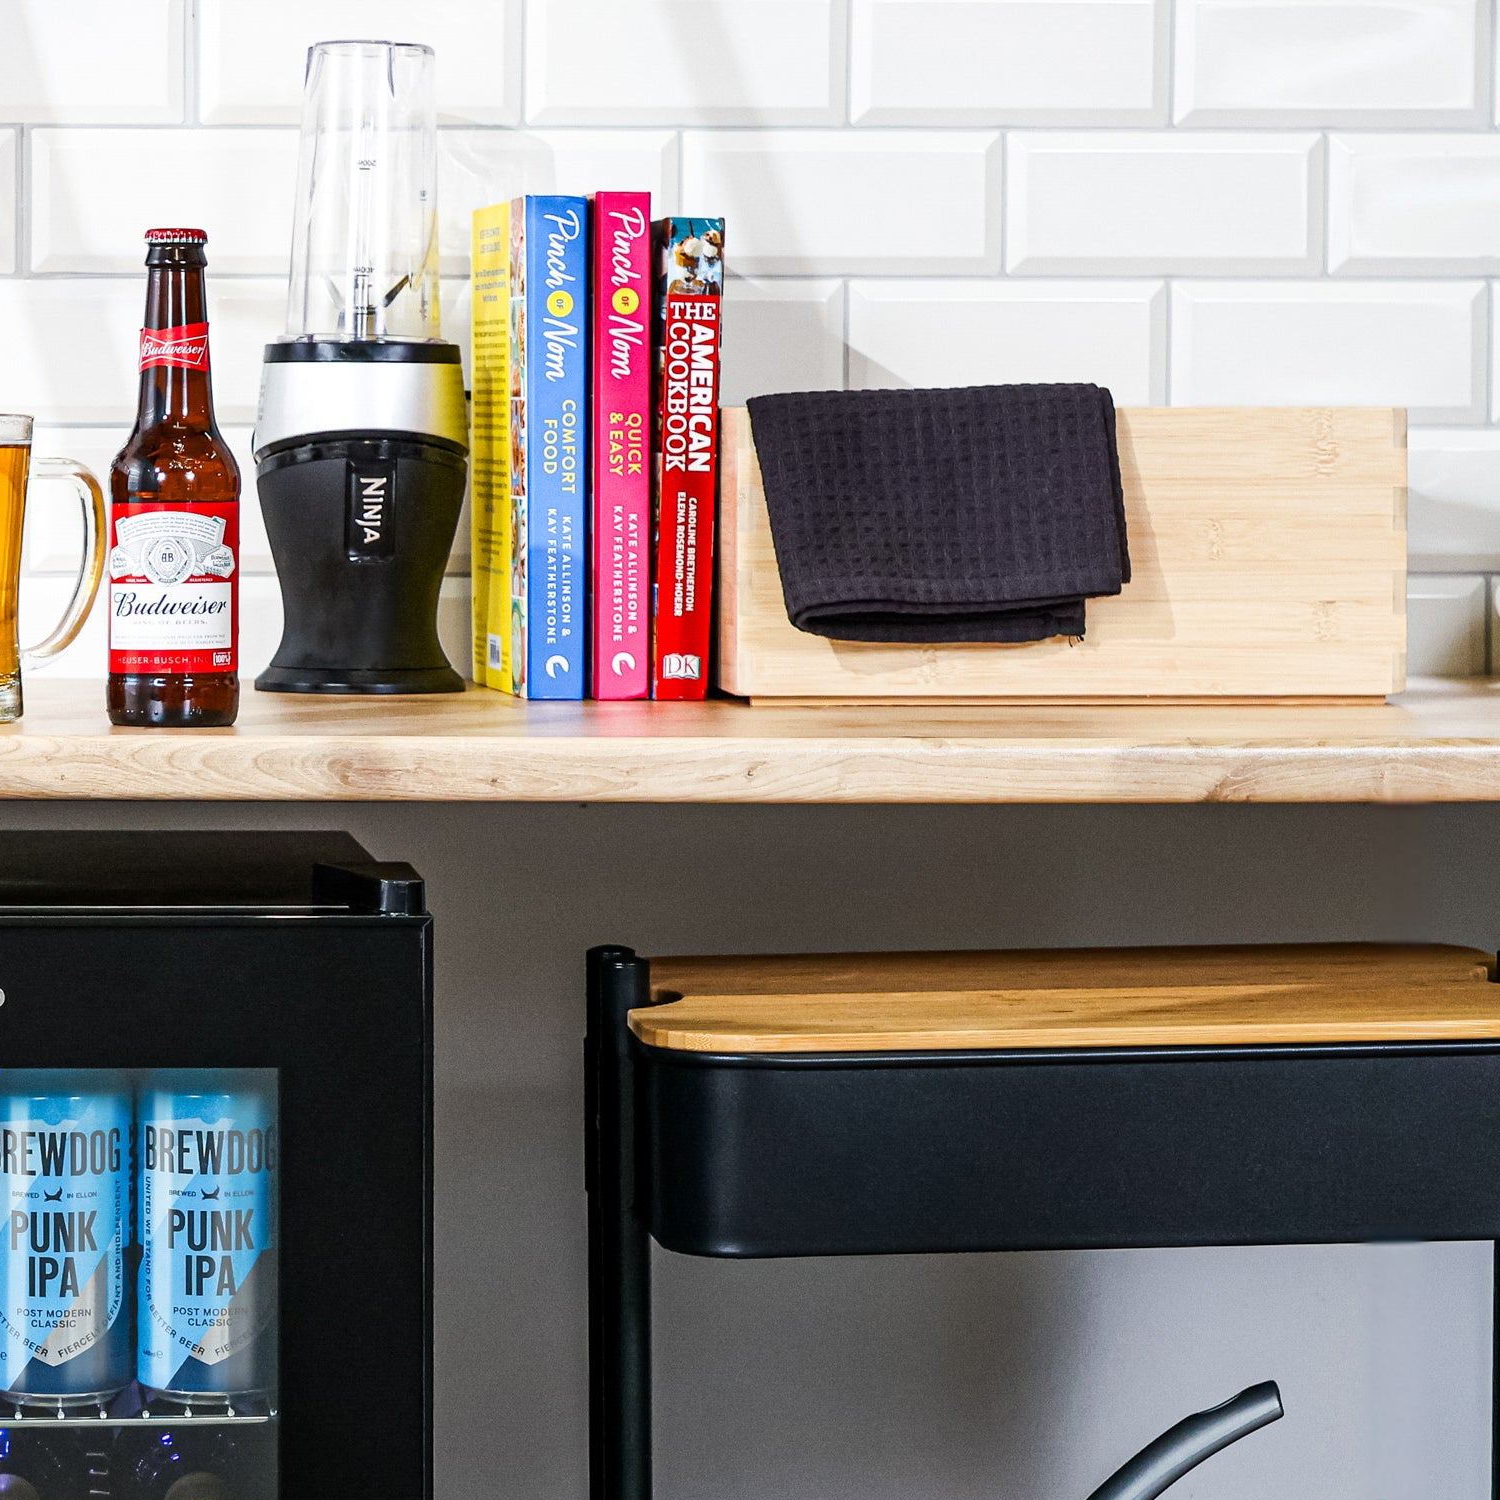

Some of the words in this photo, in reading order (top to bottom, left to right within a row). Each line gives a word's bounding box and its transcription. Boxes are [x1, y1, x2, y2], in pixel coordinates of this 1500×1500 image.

[543, 209, 581, 289] Pinch
[608, 206, 646, 287] Pinch
[555, 298, 564, 309] OF
[621, 296, 630, 306] OF
[669, 301, 716, 320] THE
[142, 341, 204, 357] Budweiser
[542, 317, 579, 382] Nom
[607, 314, 645, 380] Nom
[665, 322, 691, 473] COOKBOOK
[687, 323, 715, 472] AMERICAN
[609, 412, 624, 424] &
[543, 419, 558, 474] FOOD
[561, 399, 577, 494] COMFORT
[609, 431, 624, 476] EASY
[624, 413, 642, 475] QUICK
[355, 476, 387, 544] NINJA
[547, 508, 558, 534] KAY
[613, 505, 623, 532] KAY
[677, 492, 687, 524] ELENA
[688, 497, 698, 546] CAROLINE
[561, 516, 572, 550] KATE
[628, 513, 638, 547] KATE
[561, 555, 572, 623] ALLINSON
[612, 537, 623, 642] FEATHERSTONE
[628, 553, 638, 621] ALLINSON
[674, 525, 686, 617] ROSEMOND-HOERR
[685, 548, 697, 612] BRETHERTON
[113, 592, 227, 617] Budweiser
[546, 540, 557, 645] FEATHERSTONE
[561, 628, 571, 637] &
[627, 625, 637, 634] &
[667, 659, 698, 674] DK
[145, 1125, 277, 1176] BREWDOG
[11, 1190, 40, 1199] BREWED
[75, 1191, 98, 1199] ELLON
[11, 1210, 98, 1253] PUNK
[145, 1219, 151, 1235] WE
[167, 1208, 255, 1252] PUNK
[28, 1256, 80, 1298] IPA
[145, 1278, 153, 1301] FOR
[185, 1254, 237, 1296] IPA
[16, 1308, 43, 1318] POST
[46, 1308, 92, 1318] MODERN
[30, 1319, 77, 1328] CLASSIC
[102, 1285, 121, 1328] DEFIANT
[149, 1304, 177, 1339] BETTER
[173, 1306, 200, 1317] POST
[187, 1318, 233, 1327] CLASSIC
[22, 1337, 49, 1358] BEER
[178, 1336, 205, 1356] BEER
